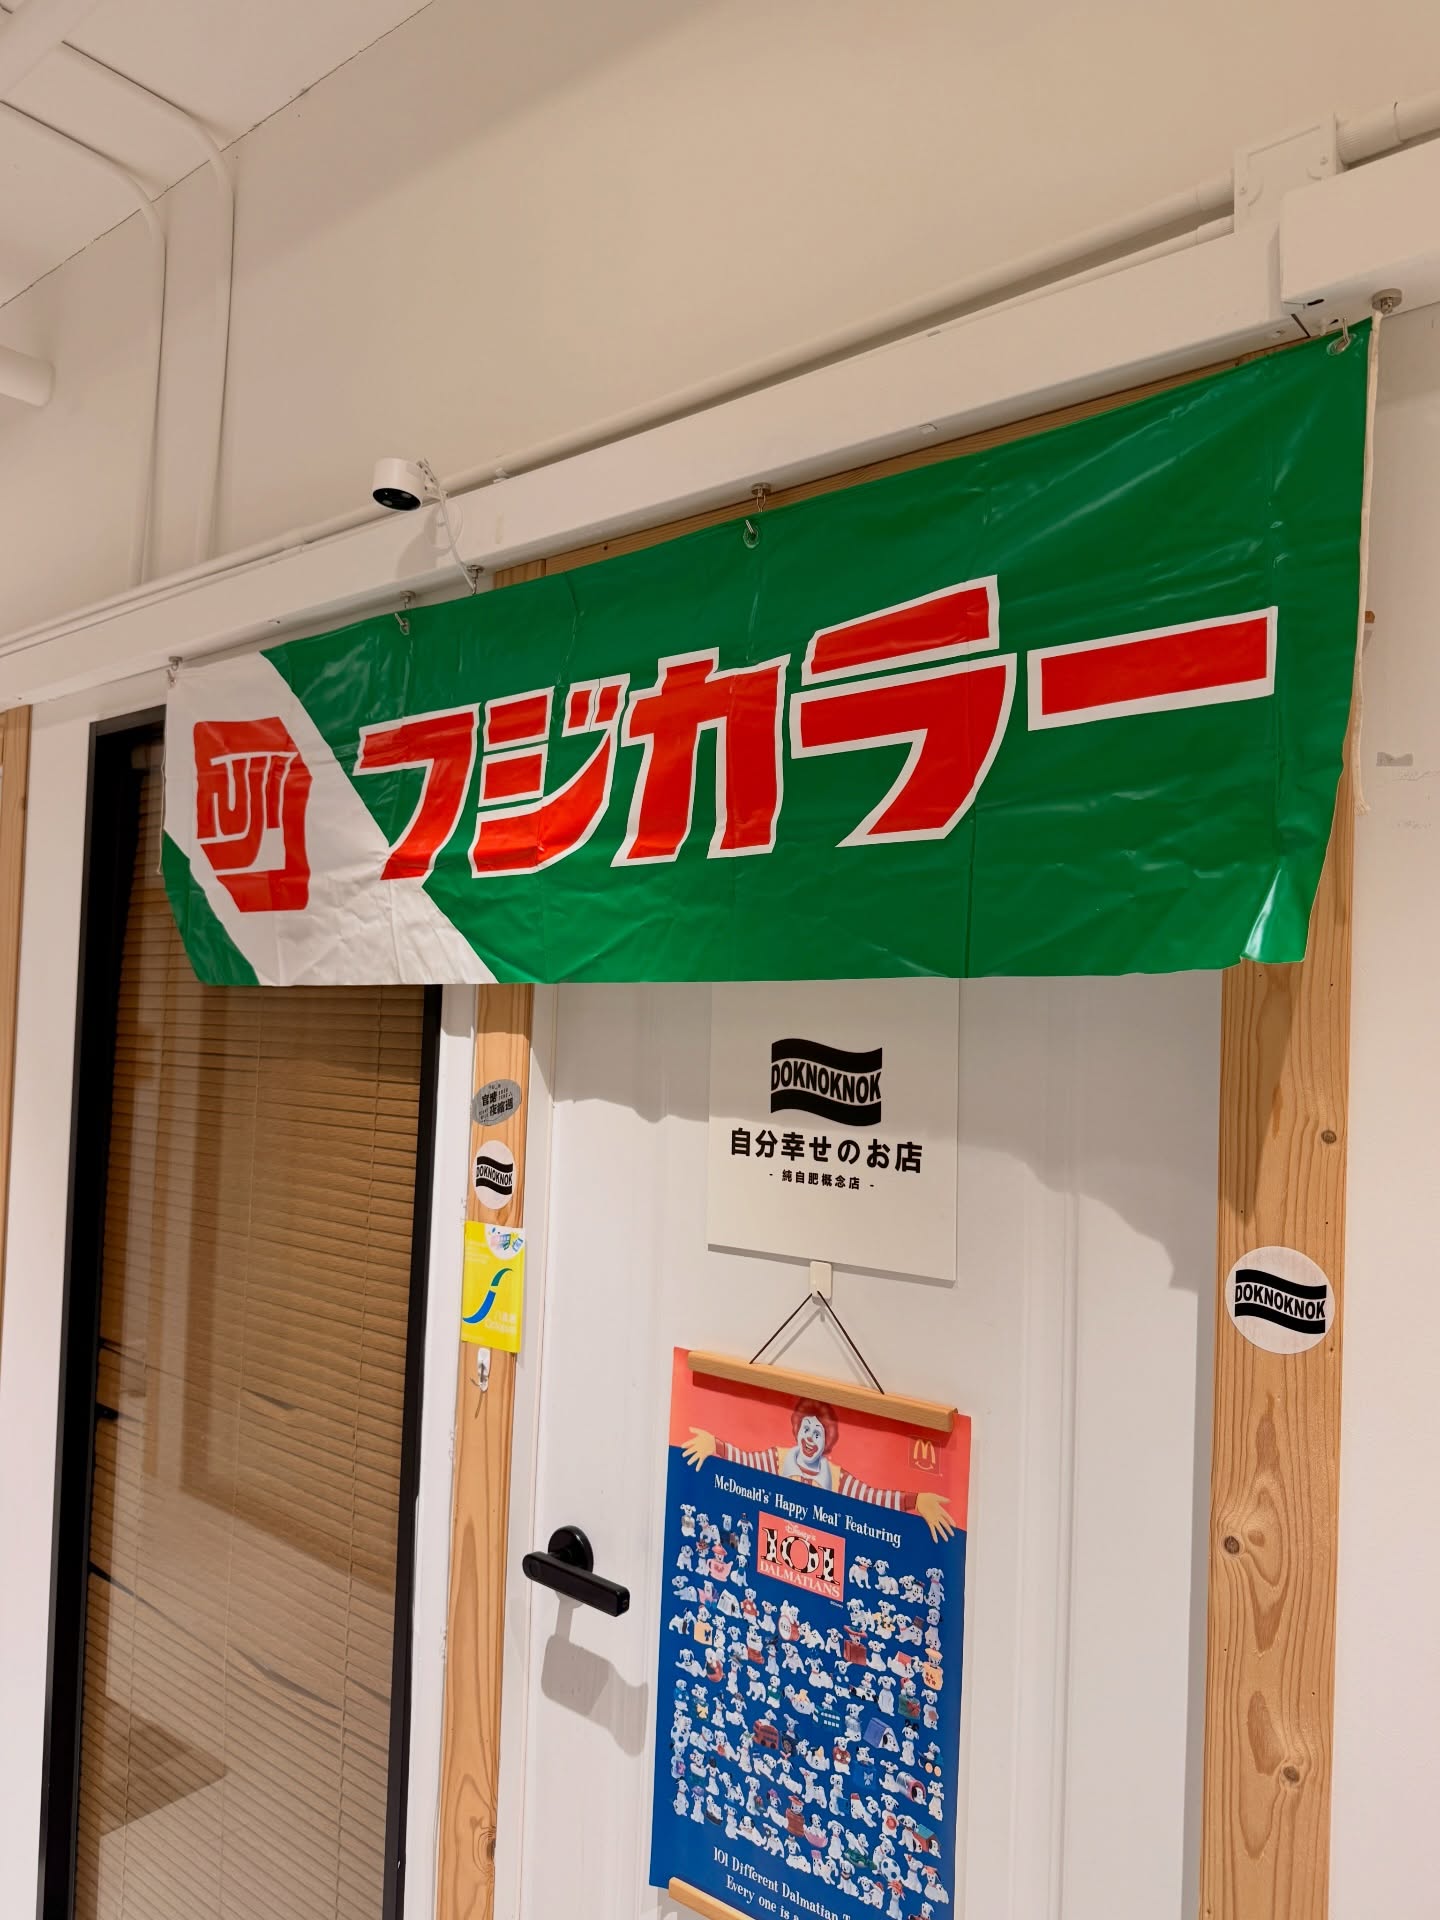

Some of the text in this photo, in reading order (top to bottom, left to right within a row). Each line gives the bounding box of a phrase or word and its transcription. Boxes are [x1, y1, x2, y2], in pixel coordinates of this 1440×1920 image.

[353, 575, 1278, 880] フジカラー
[770, 1060, 882, 1104] DOKNOKNOK
[730, 1127, 923, 1174] 自分幸せのお店
[476, 1164, 513, 1186] DOKNOKNOK
[1234, 1283, 1326, 1319] DOKNOKNOK
[714, 1474, 902, 1549] McDonald's Happy Meal Featuring
[760, 1527, 841, 1586] 101
[760, 1560, 841, 1598] DALMATIANS
[713, 1846, 729, 1867] 101
[731, 1855, 779, 1893] Different
[726, 1874, 755, 1904] Every
[758, 1896, 777, 1913] one
[779, 1905, 790, 1920] is
